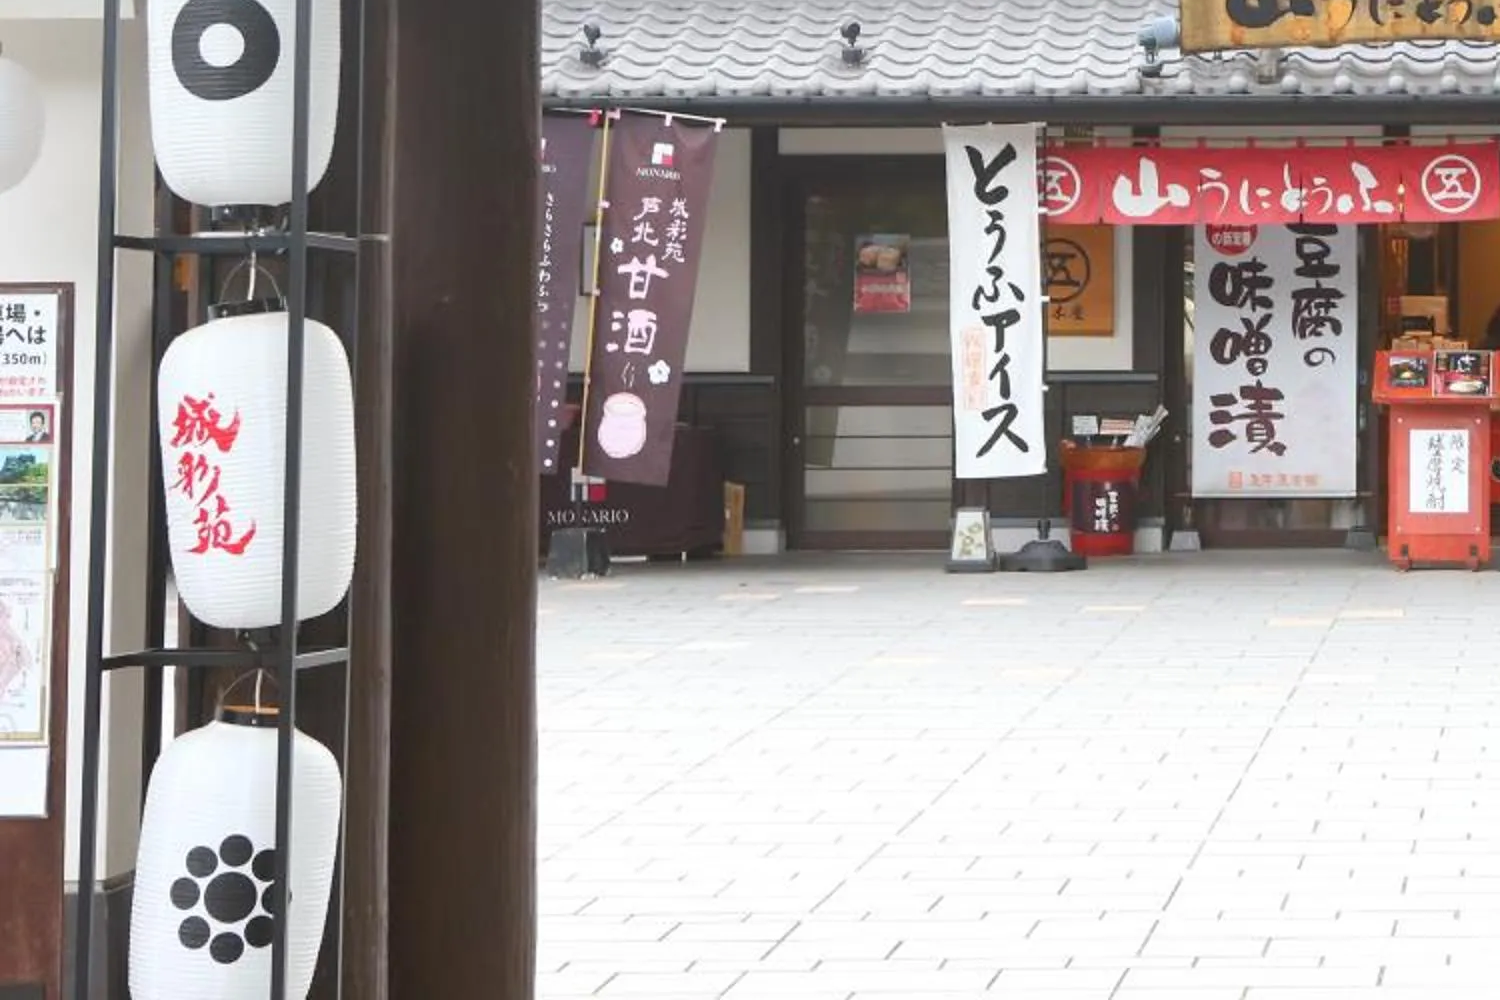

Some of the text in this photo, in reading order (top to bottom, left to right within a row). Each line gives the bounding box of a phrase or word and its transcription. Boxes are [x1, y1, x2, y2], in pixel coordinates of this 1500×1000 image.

[1112, 157, 1396, 217] 山うにとうふ
[0, 303, 41, 323] 場・
[0, 326, 46, 345] へは
[605, 253, 670, 355] 甘酒
[965, 142, 1029, 458] とうふアイス
[1285, 222, 1346, 368] 豆腐の
[1207, 256, 1287, 456] 味噌漬
[168, 392, 257, 556] 城彩苑
[548, 509, 630, 526] MOARIO
